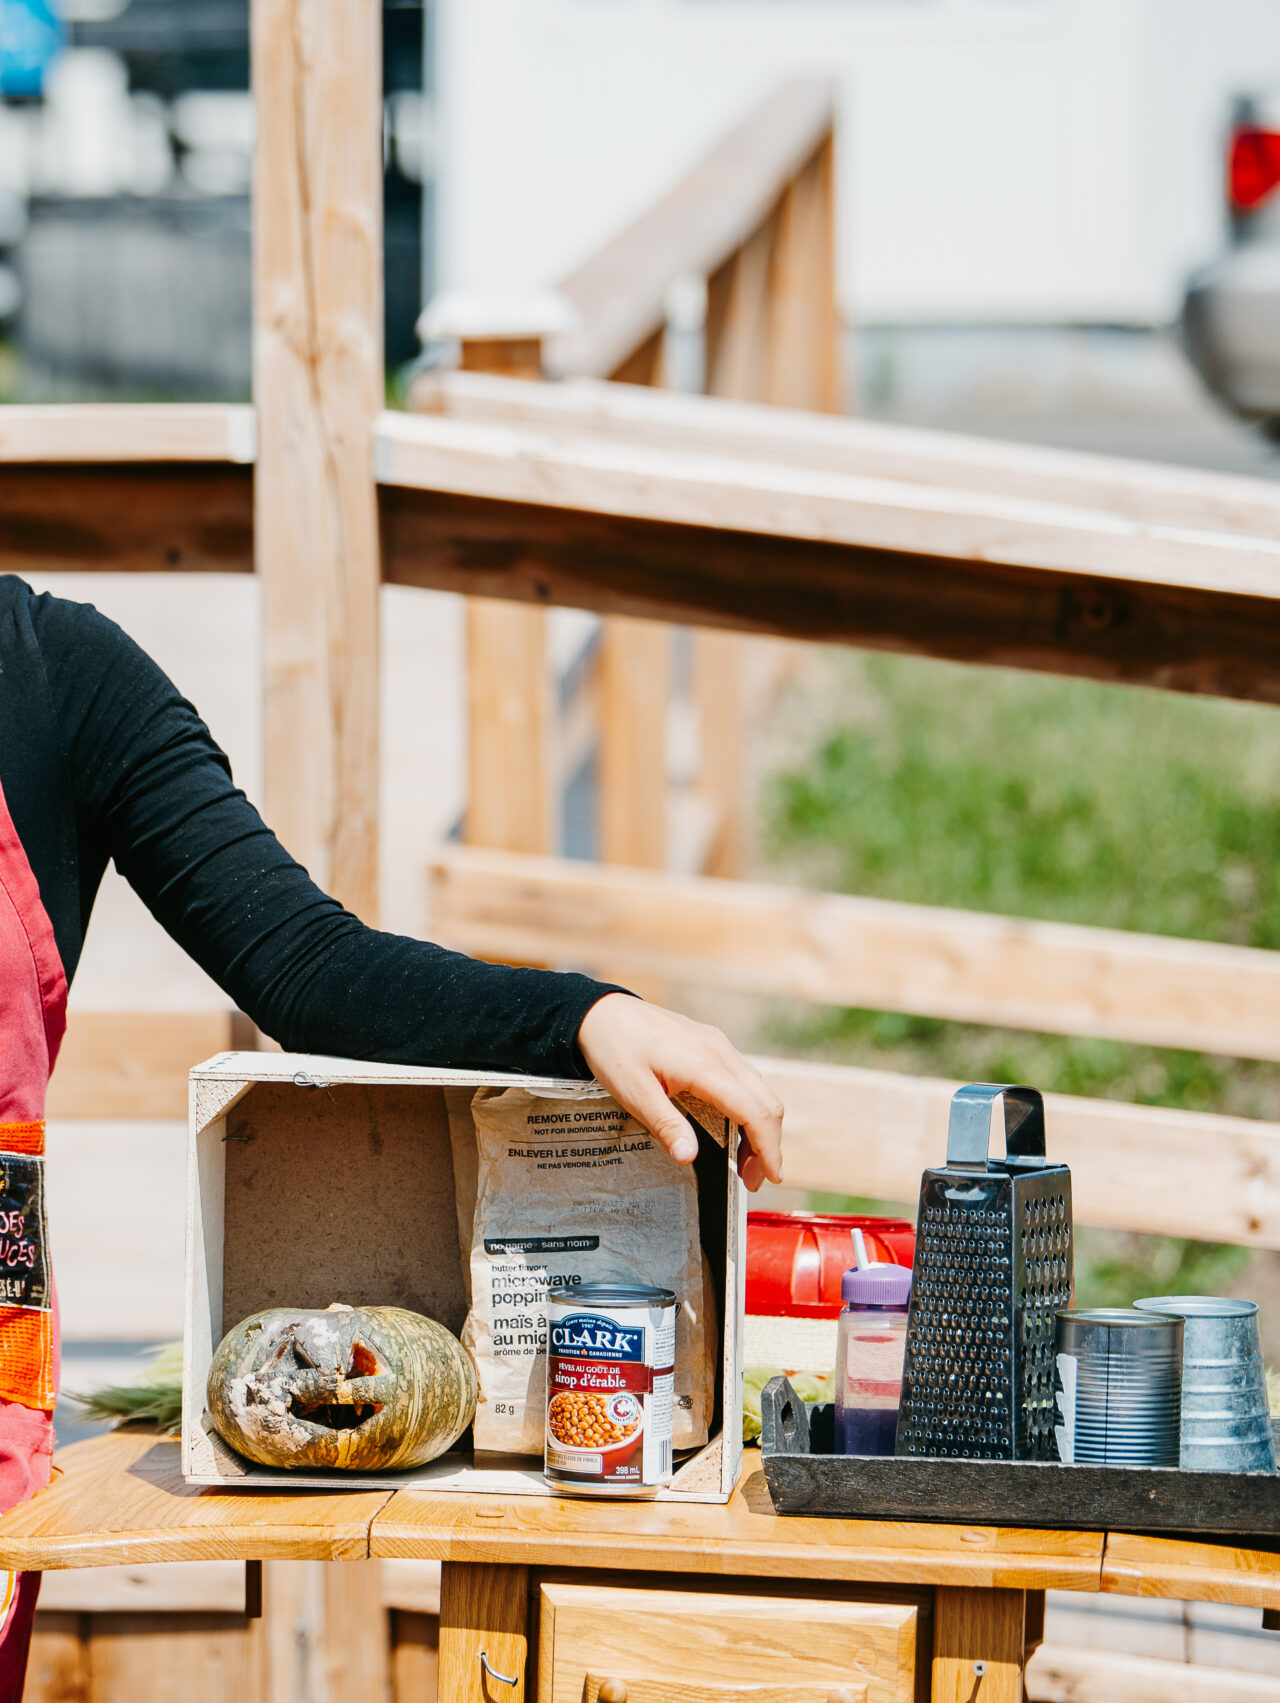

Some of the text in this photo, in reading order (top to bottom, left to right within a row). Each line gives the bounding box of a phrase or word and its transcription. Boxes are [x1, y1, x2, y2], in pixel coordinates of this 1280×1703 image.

[527, 1113, 572, 1126] REMOVE
[534, 1128, 550, 1136] NOT
[550, 1127, 566, 1135] FOR
[567, 1126, 608, 1134] INDIVIDUAL
[508, 1141, 655, 1159] ENLEVER LE SUREMBALLAGE.
[537, 1162, 548, 1171] NE
[548, 1162, 562, 1170] PAS
[562, 1160, 592, 1170] VENDRE
[591, 1159, 598, 1168] À
[504, 1240, 533, 1251] name
[541, 1240, 566, 1250] sans
[566, 1238, 590, 1249] nom
[491, 1264, 548, 1272] butter flavour
[491, 1273, 582, 1289] microwave
[492, 1290, 548, 1308] poppin
[493, 1314, 547, 1330] maïs à
[493, 1334, 516, 1346] au
[552, 1327, 632, 1353] CLARK
[493, 1348, 521, 1356] arôme
[522, 1347, 534, 1356] de
[558, 1348, 623, 1358] TRADITION CANADIENNE
[575, 1365, 585, 1373] AU
[585, 1364, 608, 1374] GOÛT
[555, 1371, 627, 1389] sirop d'érable
[494, 1403, 515, 1416] 82 g
[615, 1465, 640, 1475] 398 mL
